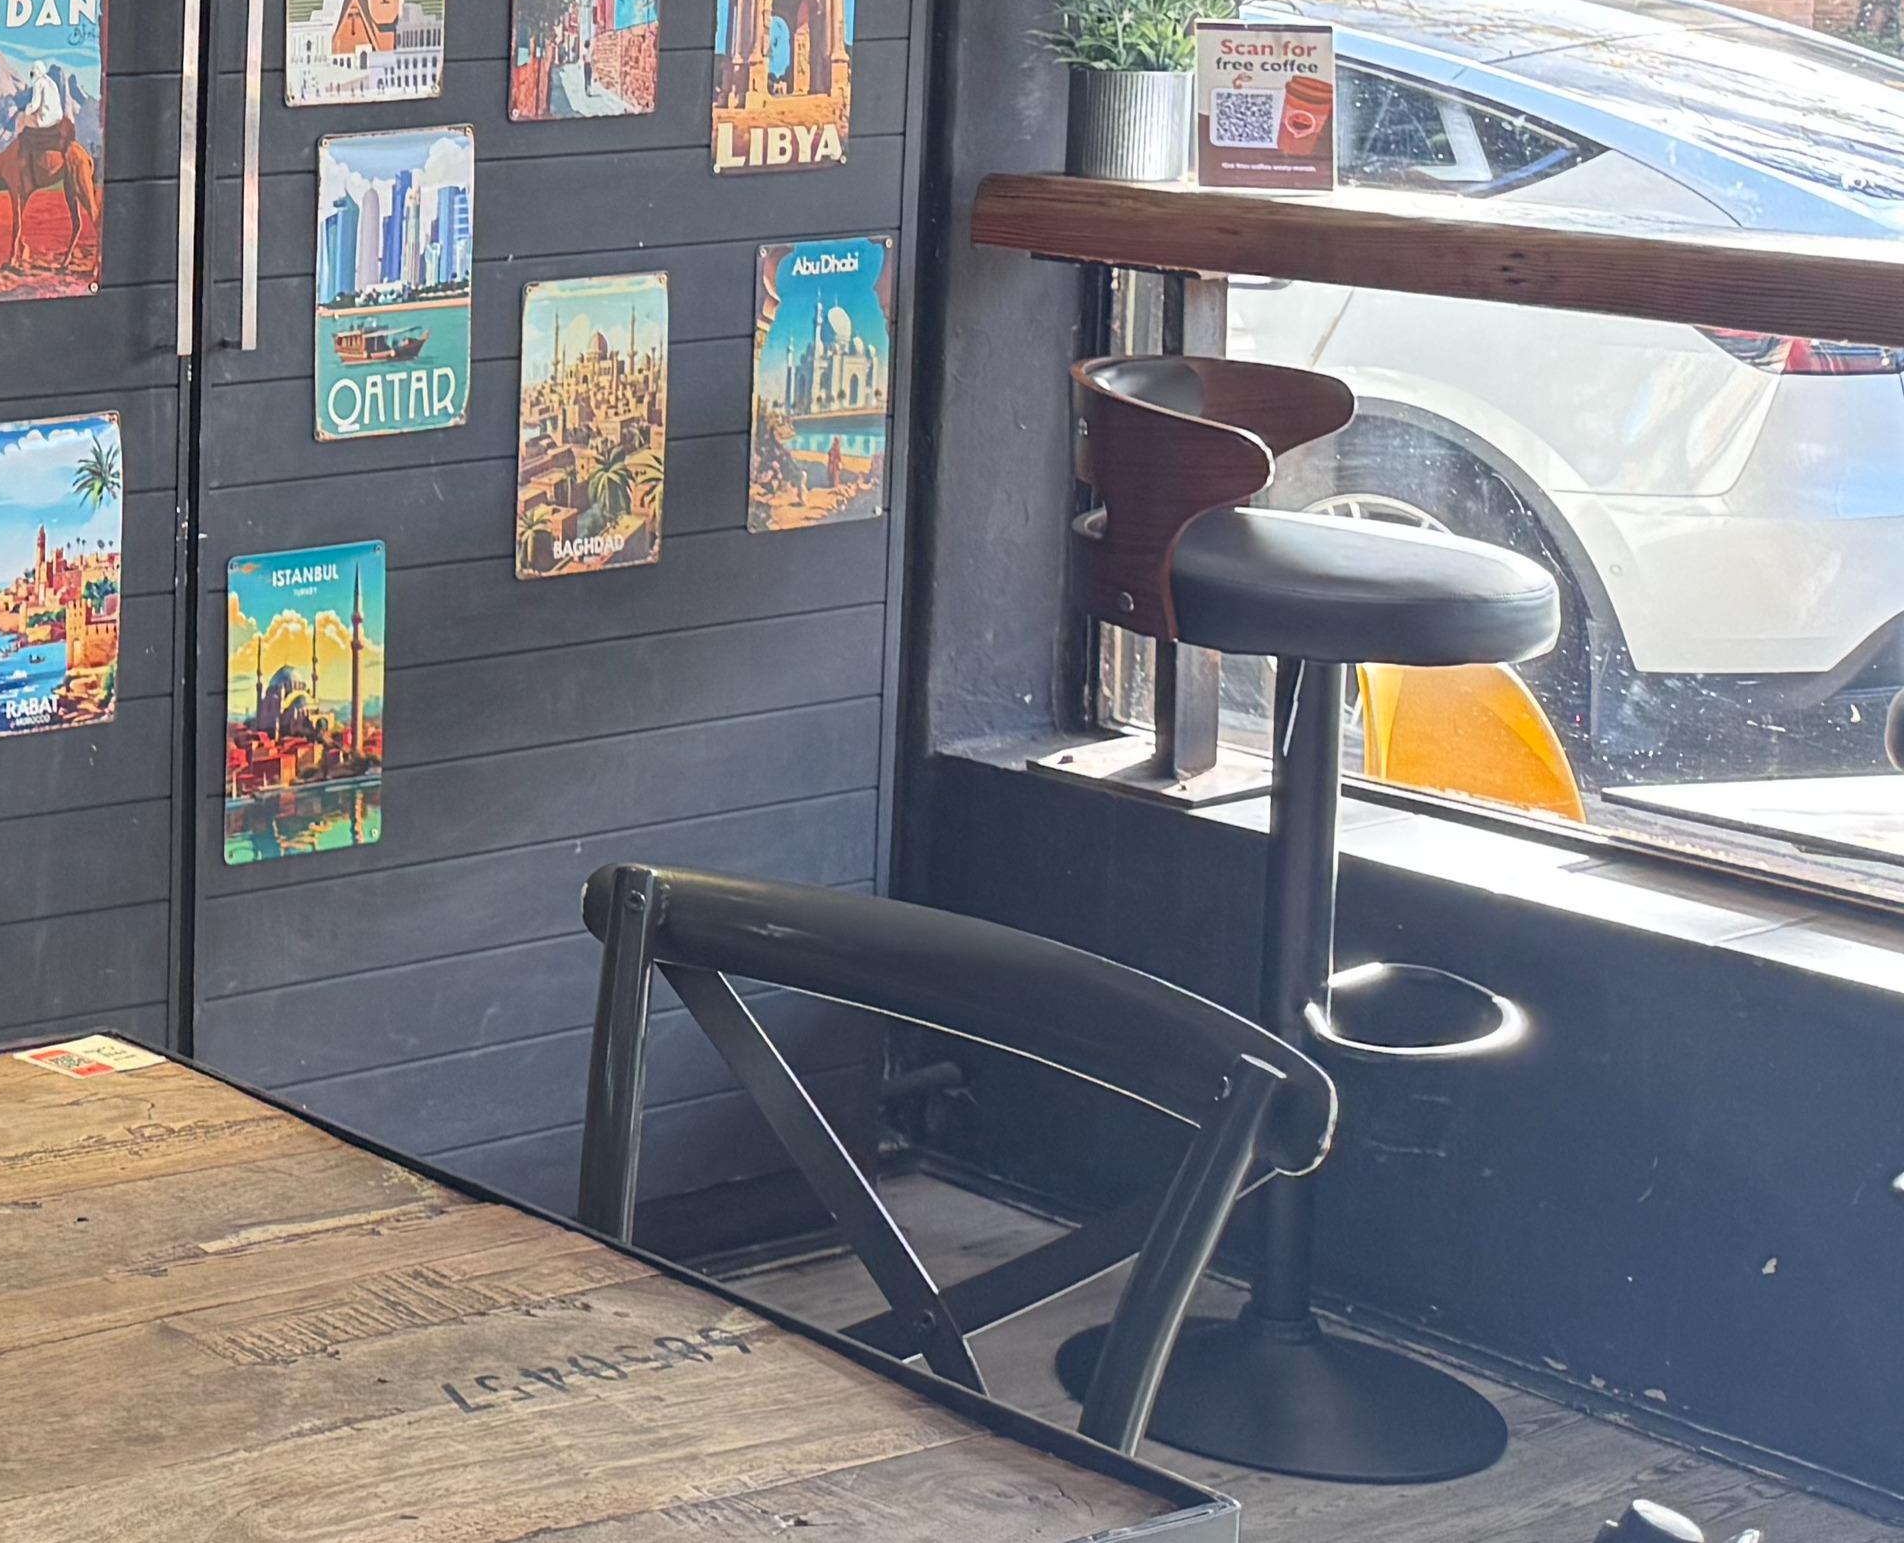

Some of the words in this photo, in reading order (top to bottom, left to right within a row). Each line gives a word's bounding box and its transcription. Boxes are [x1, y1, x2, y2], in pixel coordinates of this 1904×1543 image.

[1221, 39, 1274, 56] Scan
[1282, 41, 1317, 57] for
[1216, 58, 1253, 71] free
[1260, 60, 1318, 73] coffee
[717, 123, 842, 167] LIBYA
[792, 255, 820, 275] Abu
[821, 252, 860, 273] Dhabi
[328, 367, 455, 432] QATAR
[553, 534, 624, 559] BAGHDAD
[272, 564, 339, 587] ISTANBUL
[6, 695, 59, 720] RABAT
